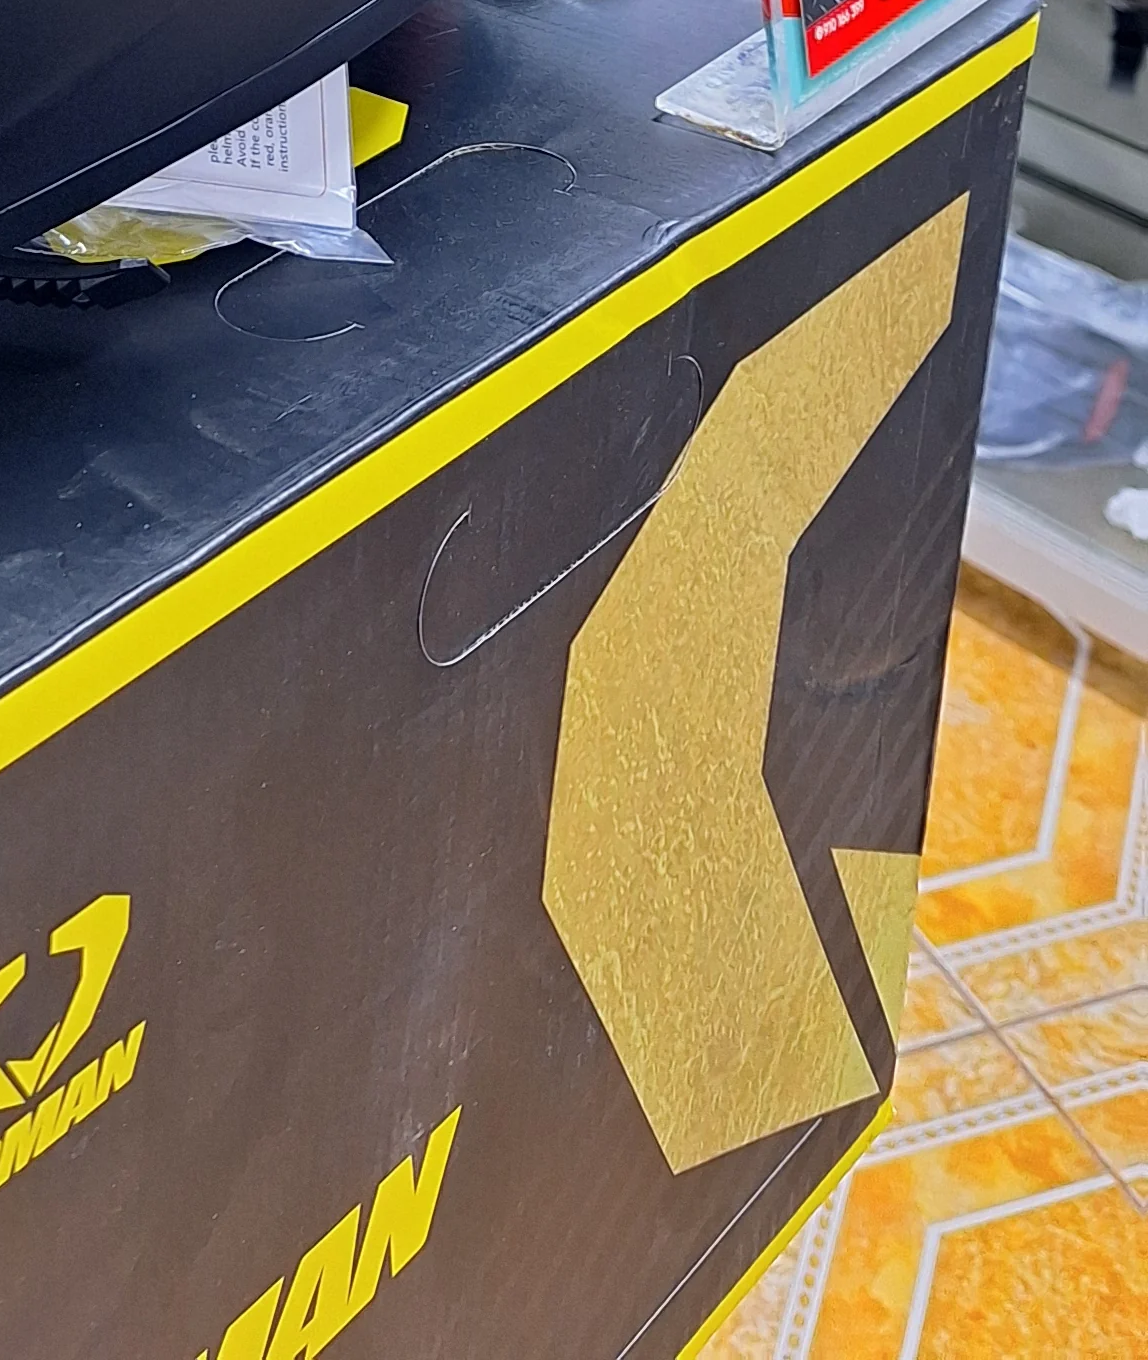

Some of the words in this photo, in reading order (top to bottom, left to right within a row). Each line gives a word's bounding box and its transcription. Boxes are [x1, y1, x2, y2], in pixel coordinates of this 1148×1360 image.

[236, 129, 247, 168] Avoid
[249, 135, 261, 156] the
[263, 142, 276, 167] red,
[249, 158, 262, 170] If
